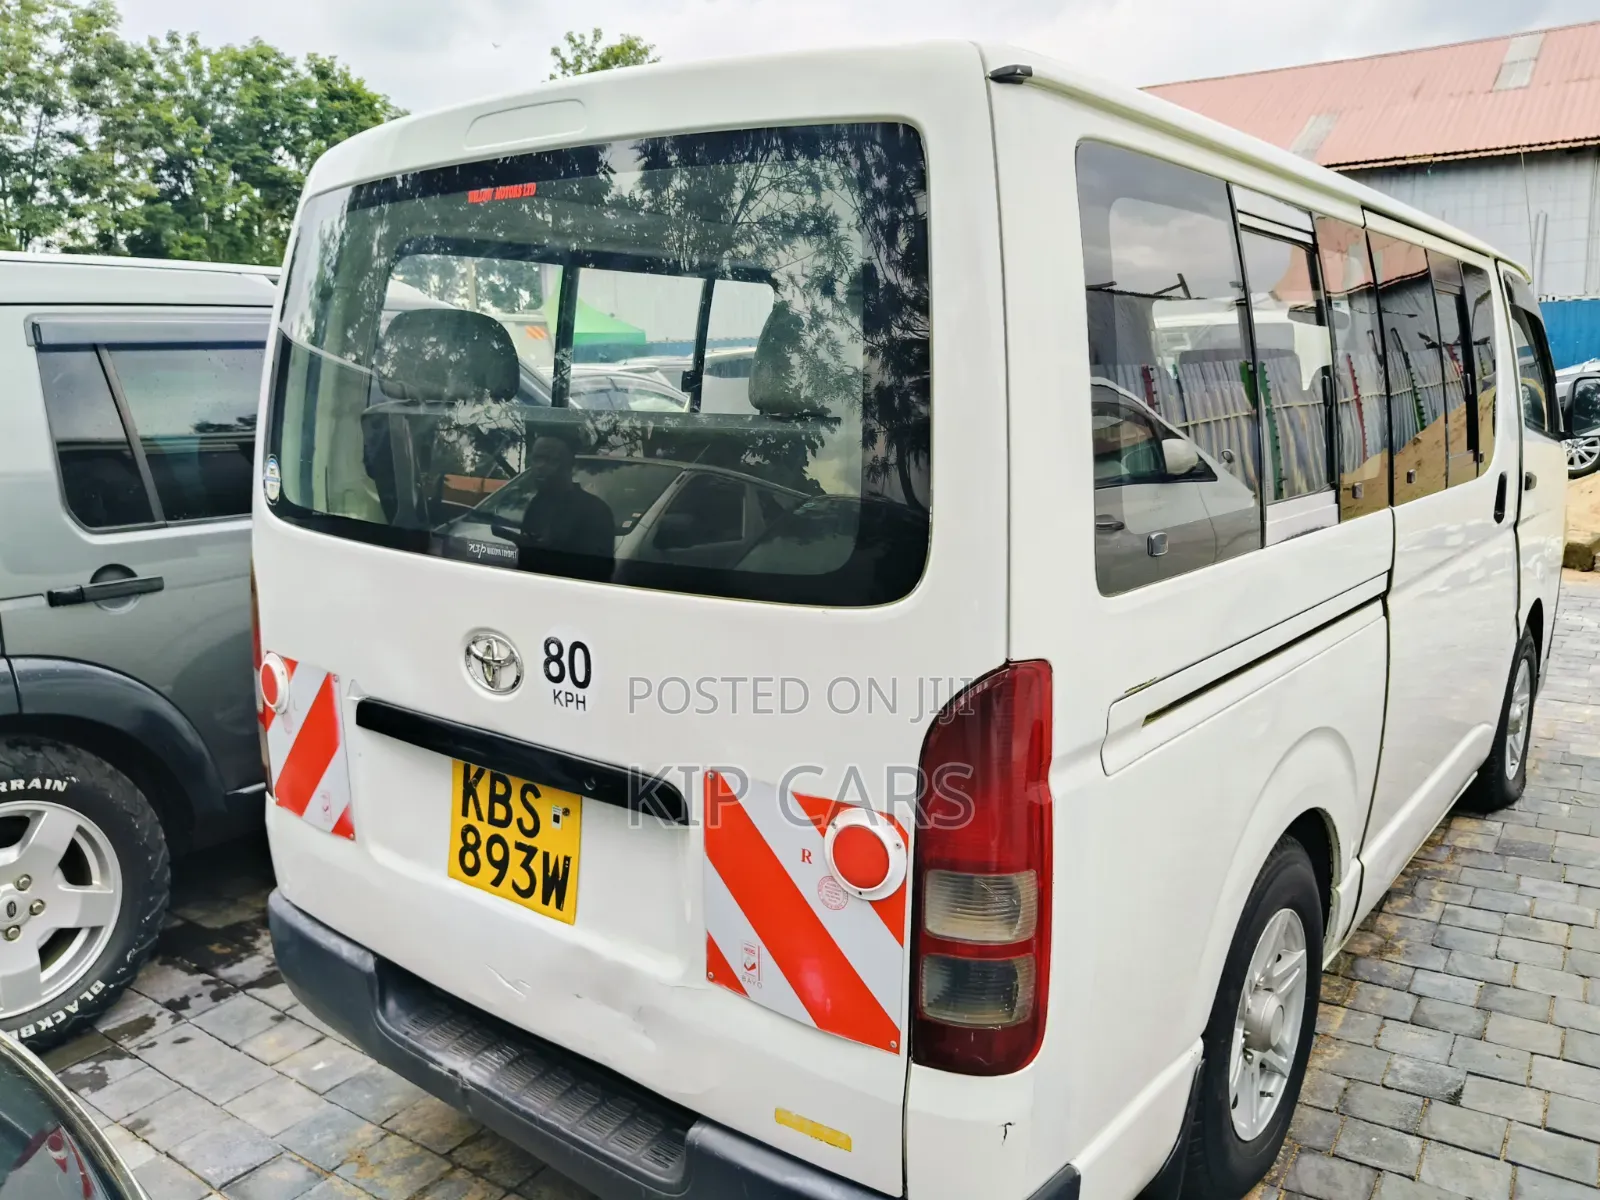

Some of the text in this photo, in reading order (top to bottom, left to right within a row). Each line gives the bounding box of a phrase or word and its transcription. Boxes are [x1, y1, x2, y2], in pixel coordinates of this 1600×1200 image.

[522, 182, 537, 197] LTD
[543, 636, 592, 689] 80
[553, 689, 587, 711] KPH
[461, 763, 542, 838] KBS
[458, 824, 572, 912] 893W
[801, 848, 813, 864] R
